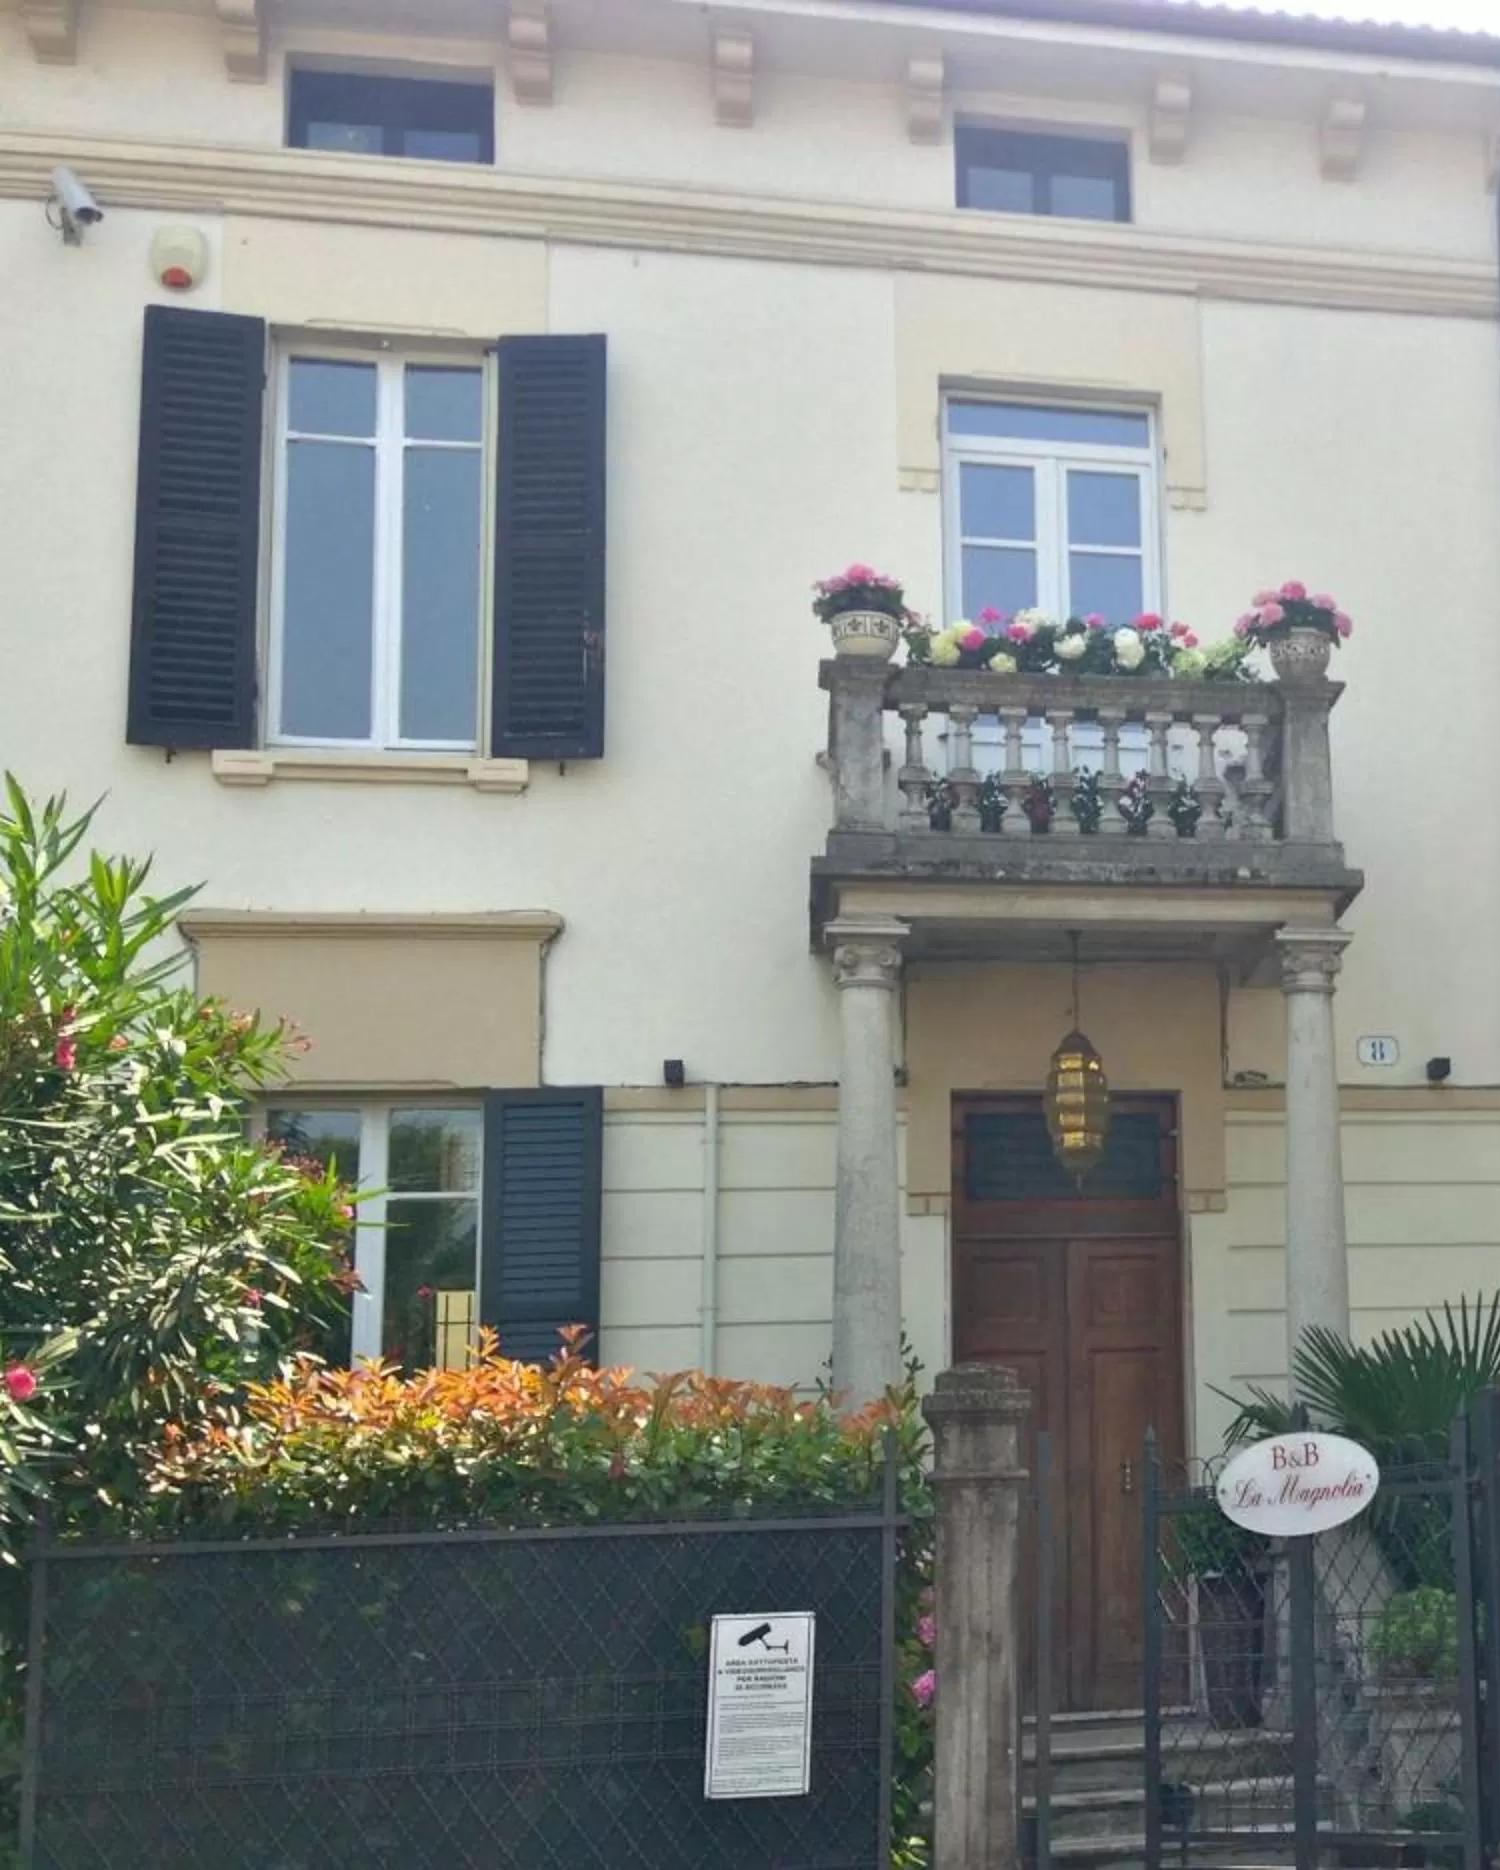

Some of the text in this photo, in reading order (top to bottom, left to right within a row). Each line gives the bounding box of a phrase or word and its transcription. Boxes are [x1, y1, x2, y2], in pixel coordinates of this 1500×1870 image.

[1371, 1040, 1386, 1062] 8
[1271, 1441, 1320, 1471] B&B
[1231, 1468, 1365, 1511] La Magnolia
